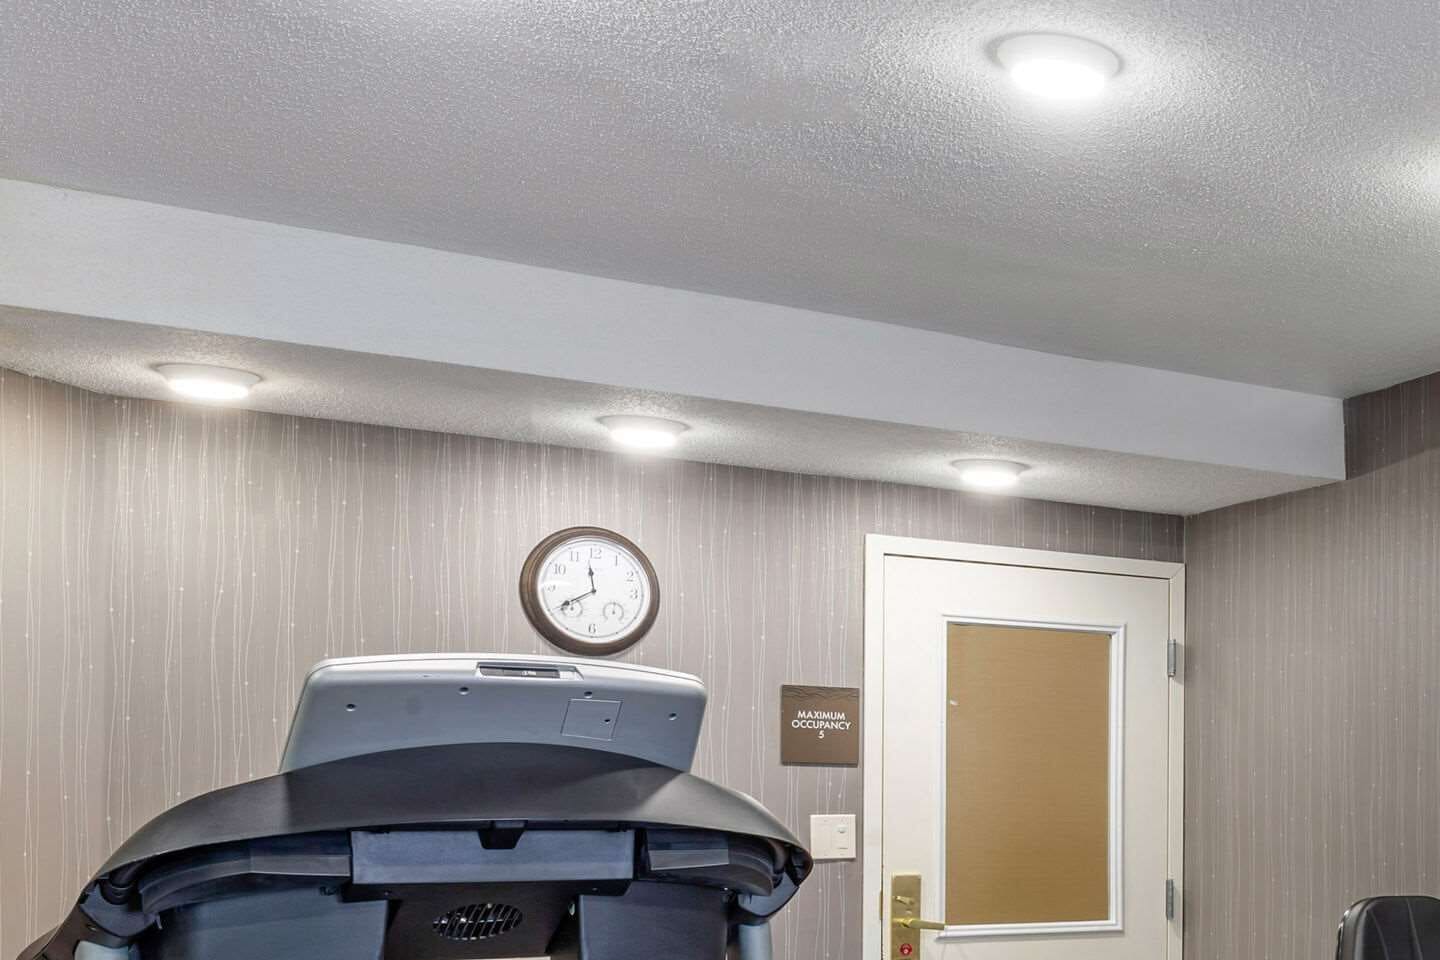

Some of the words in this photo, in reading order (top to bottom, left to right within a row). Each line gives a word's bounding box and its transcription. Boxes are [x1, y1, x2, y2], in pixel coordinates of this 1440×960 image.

[570, 551, 579, 562] 11
[589, 547, 602, 560] 12
[554, 563, 566, 575] 10
[626, 570, 634, 582] 2
[629, 588, 639, 600] 3
[588, 623, 597, 634] 6
[797, 710, 846, 721] MAXIMUM
[791, 719, 852, 730] OCCUPANCY
[817, 729, 825, 739] 5
